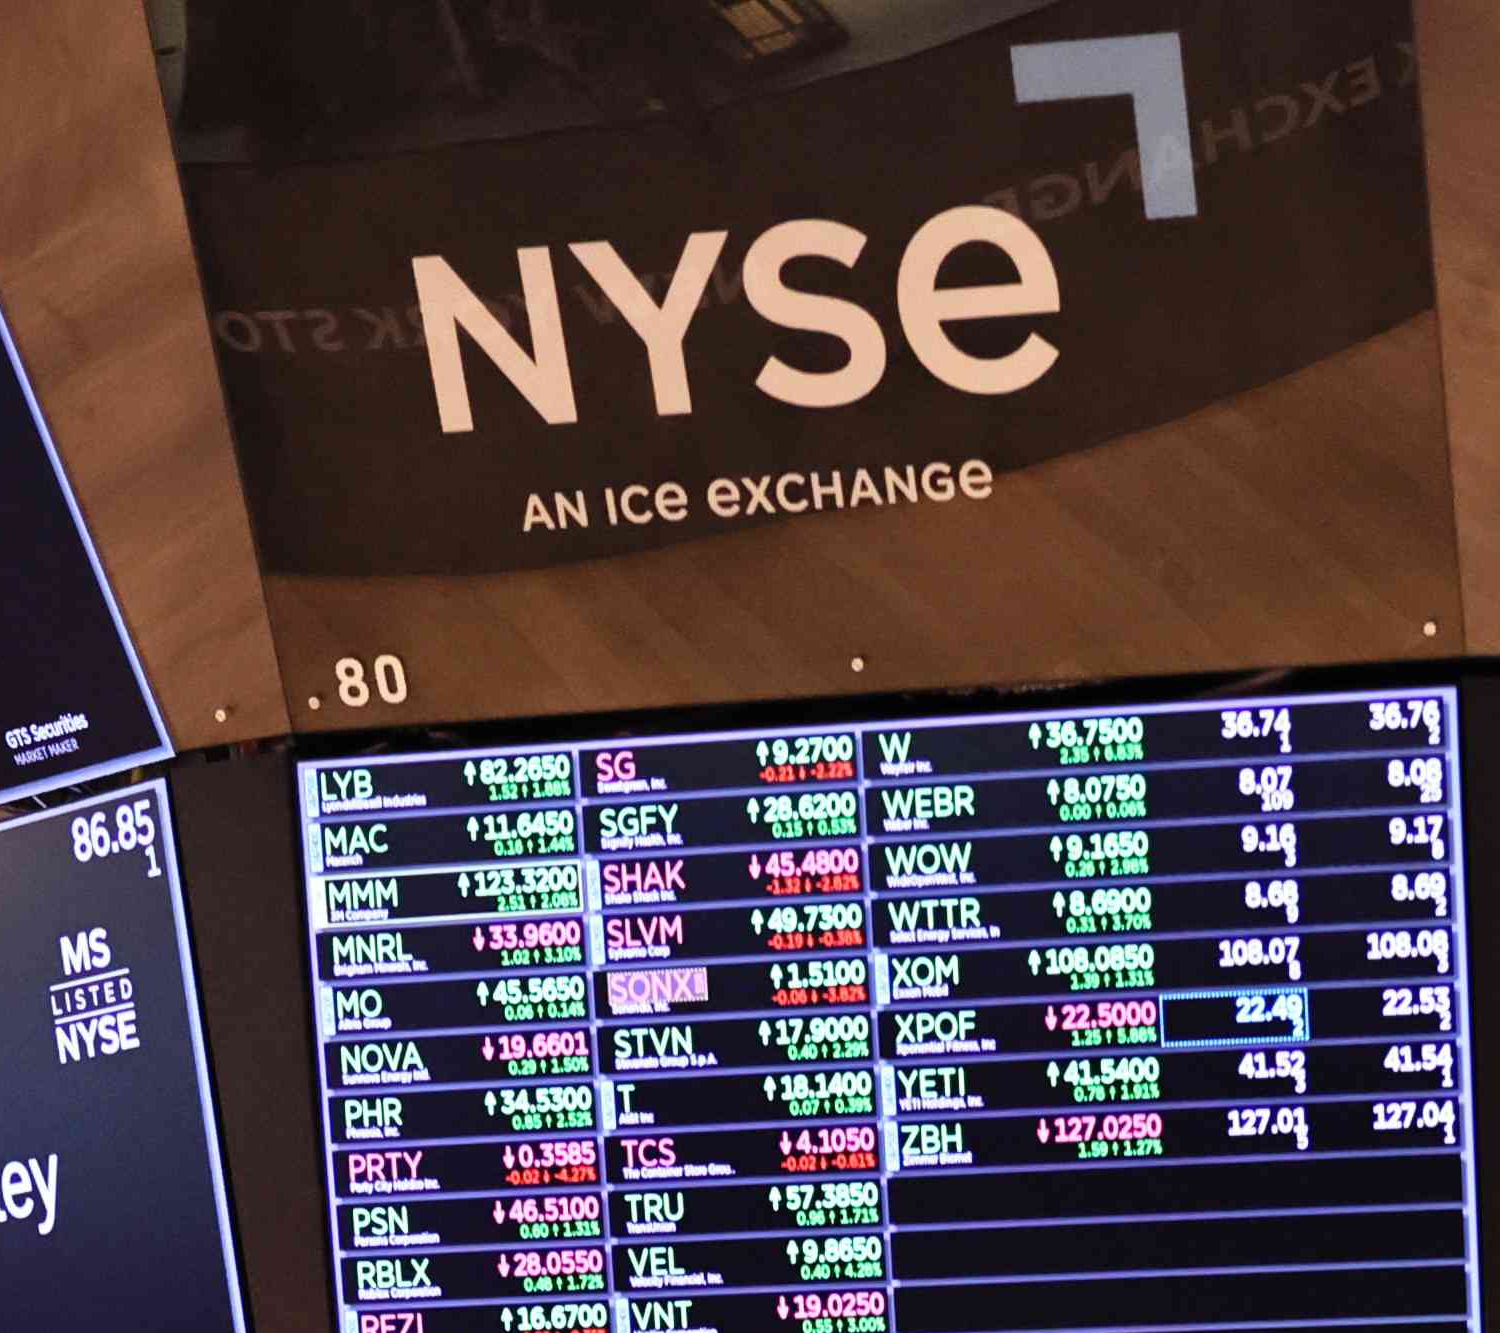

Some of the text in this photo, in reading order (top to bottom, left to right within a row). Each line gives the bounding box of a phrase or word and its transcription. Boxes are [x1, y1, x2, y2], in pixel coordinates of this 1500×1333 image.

[521, 490, 591, 534] AN
[334, 654, 409, 710] 80
[320, 753, 571, 803] LYB 82.2650
[881, 775, 1147, 818] WEBR 8.0750
[71, 800, 156, 862] 86.85
[324, 824, 389, 857] MAC
[328, 867, 578, 911] MMM 123.3200
[603, 847, 859, 893] SHAK 45.4800
[60, 927, 112, 977] MS
[890, 955, 960, 986] XOM
[51, 977, 133, 1017] LISTED
[55, 1010, 141, 1064] NYSE
[898, 1066, 966, 1097] YETI
[344, 1087, 593, 1128] PHR 34.5300
[901, 1122, 964, 1154] ZBH
[625, 1181, 879, 1223] TRU 57.3850
[356, 1250, 604, 1288] RBLX 28.0550
